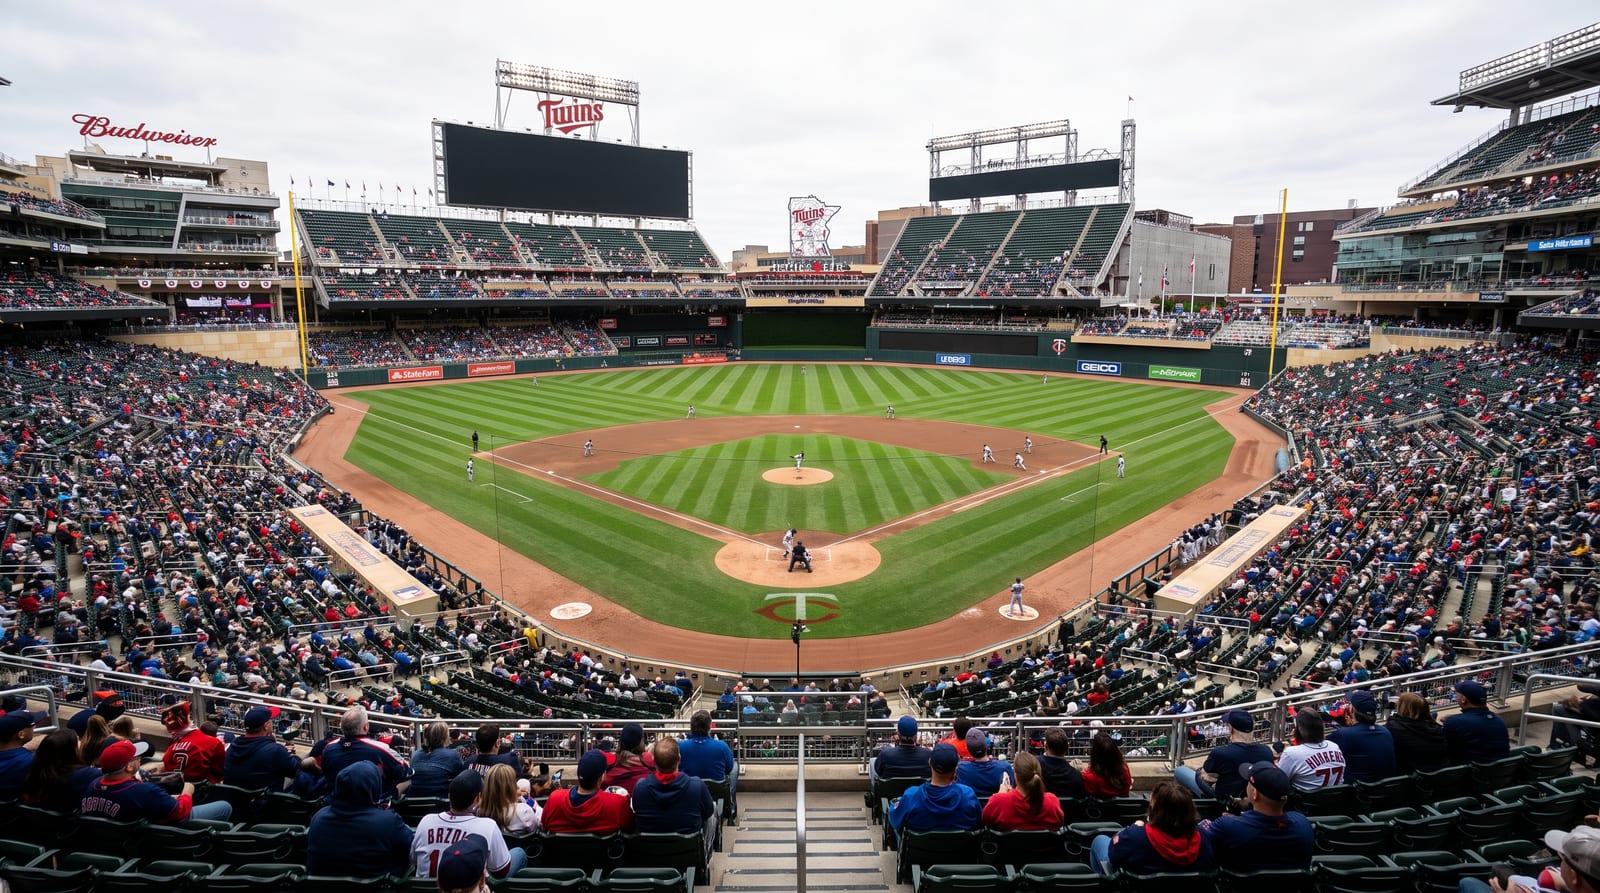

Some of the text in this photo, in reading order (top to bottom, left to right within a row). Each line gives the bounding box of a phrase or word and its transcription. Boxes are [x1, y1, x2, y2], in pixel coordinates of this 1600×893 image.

[537, 98, 604, 134] Twins
[72, 113, 217, 147] Budweiser
[792, 207, 825, 225] Twins
[1081, 363, 1118, 373] GEICO
[1315, 766, 1344, 787] 77
